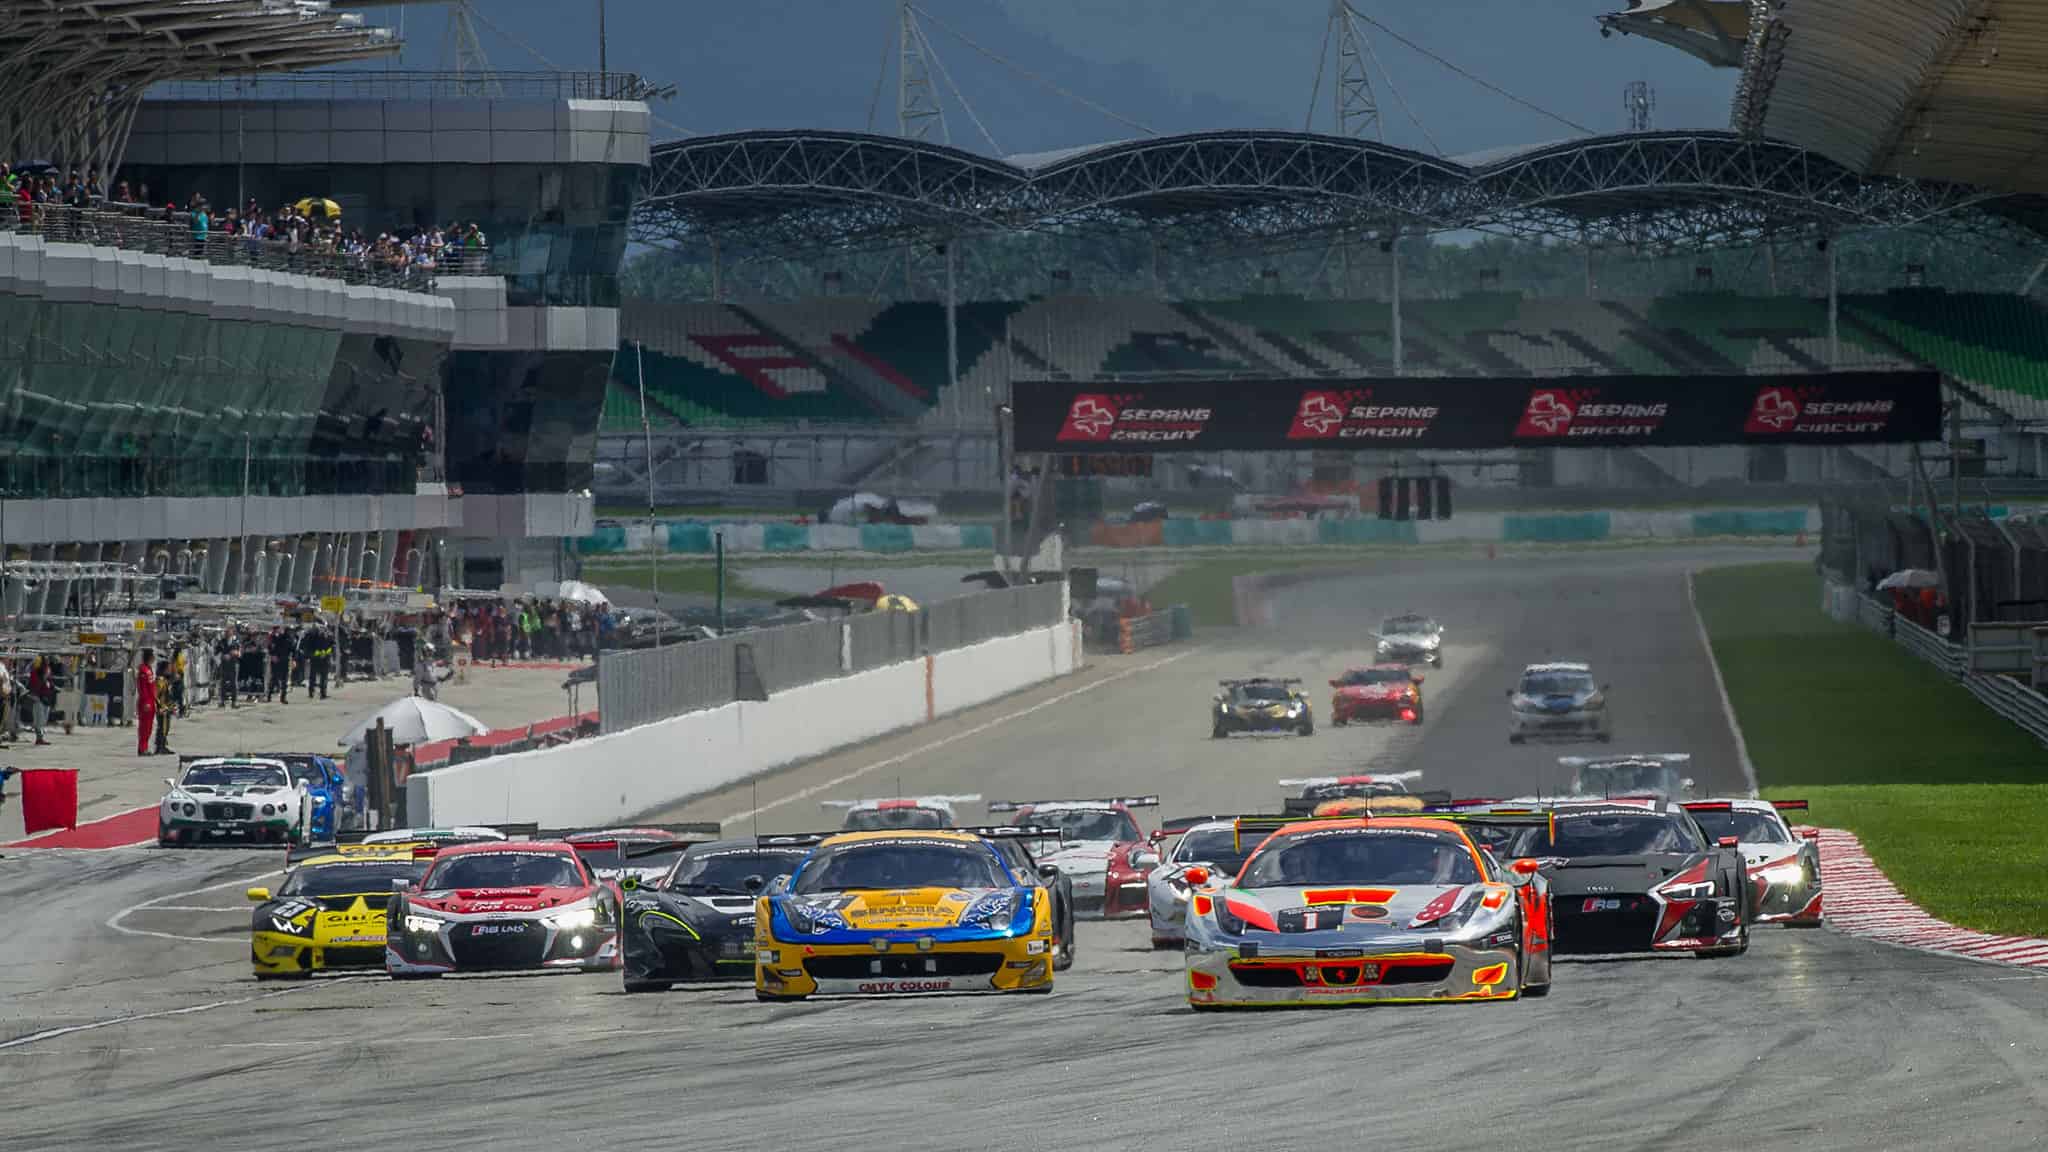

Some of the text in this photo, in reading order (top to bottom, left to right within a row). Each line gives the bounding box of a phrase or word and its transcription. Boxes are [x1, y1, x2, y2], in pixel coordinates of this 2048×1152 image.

[1350, 407, 1439, 418] SEPANG
[1577, 403, 1668, 417] SEPANG
[1804, 400, 1895, 415] SEPANG
[1120, 408, 1212, 421] SEPANG
[1339, 427, 1428, 437] CIRCUIT
[1568, 425, 1656, 436] CIRCUIT
[1794, 422, 1886, 432] CIRCUIT
[1110, 430, 1201, 441] CIRCUIT
[1303, 912, 1319, 930] 1
[859, 981, 951, 993] CMYK COLOUR
